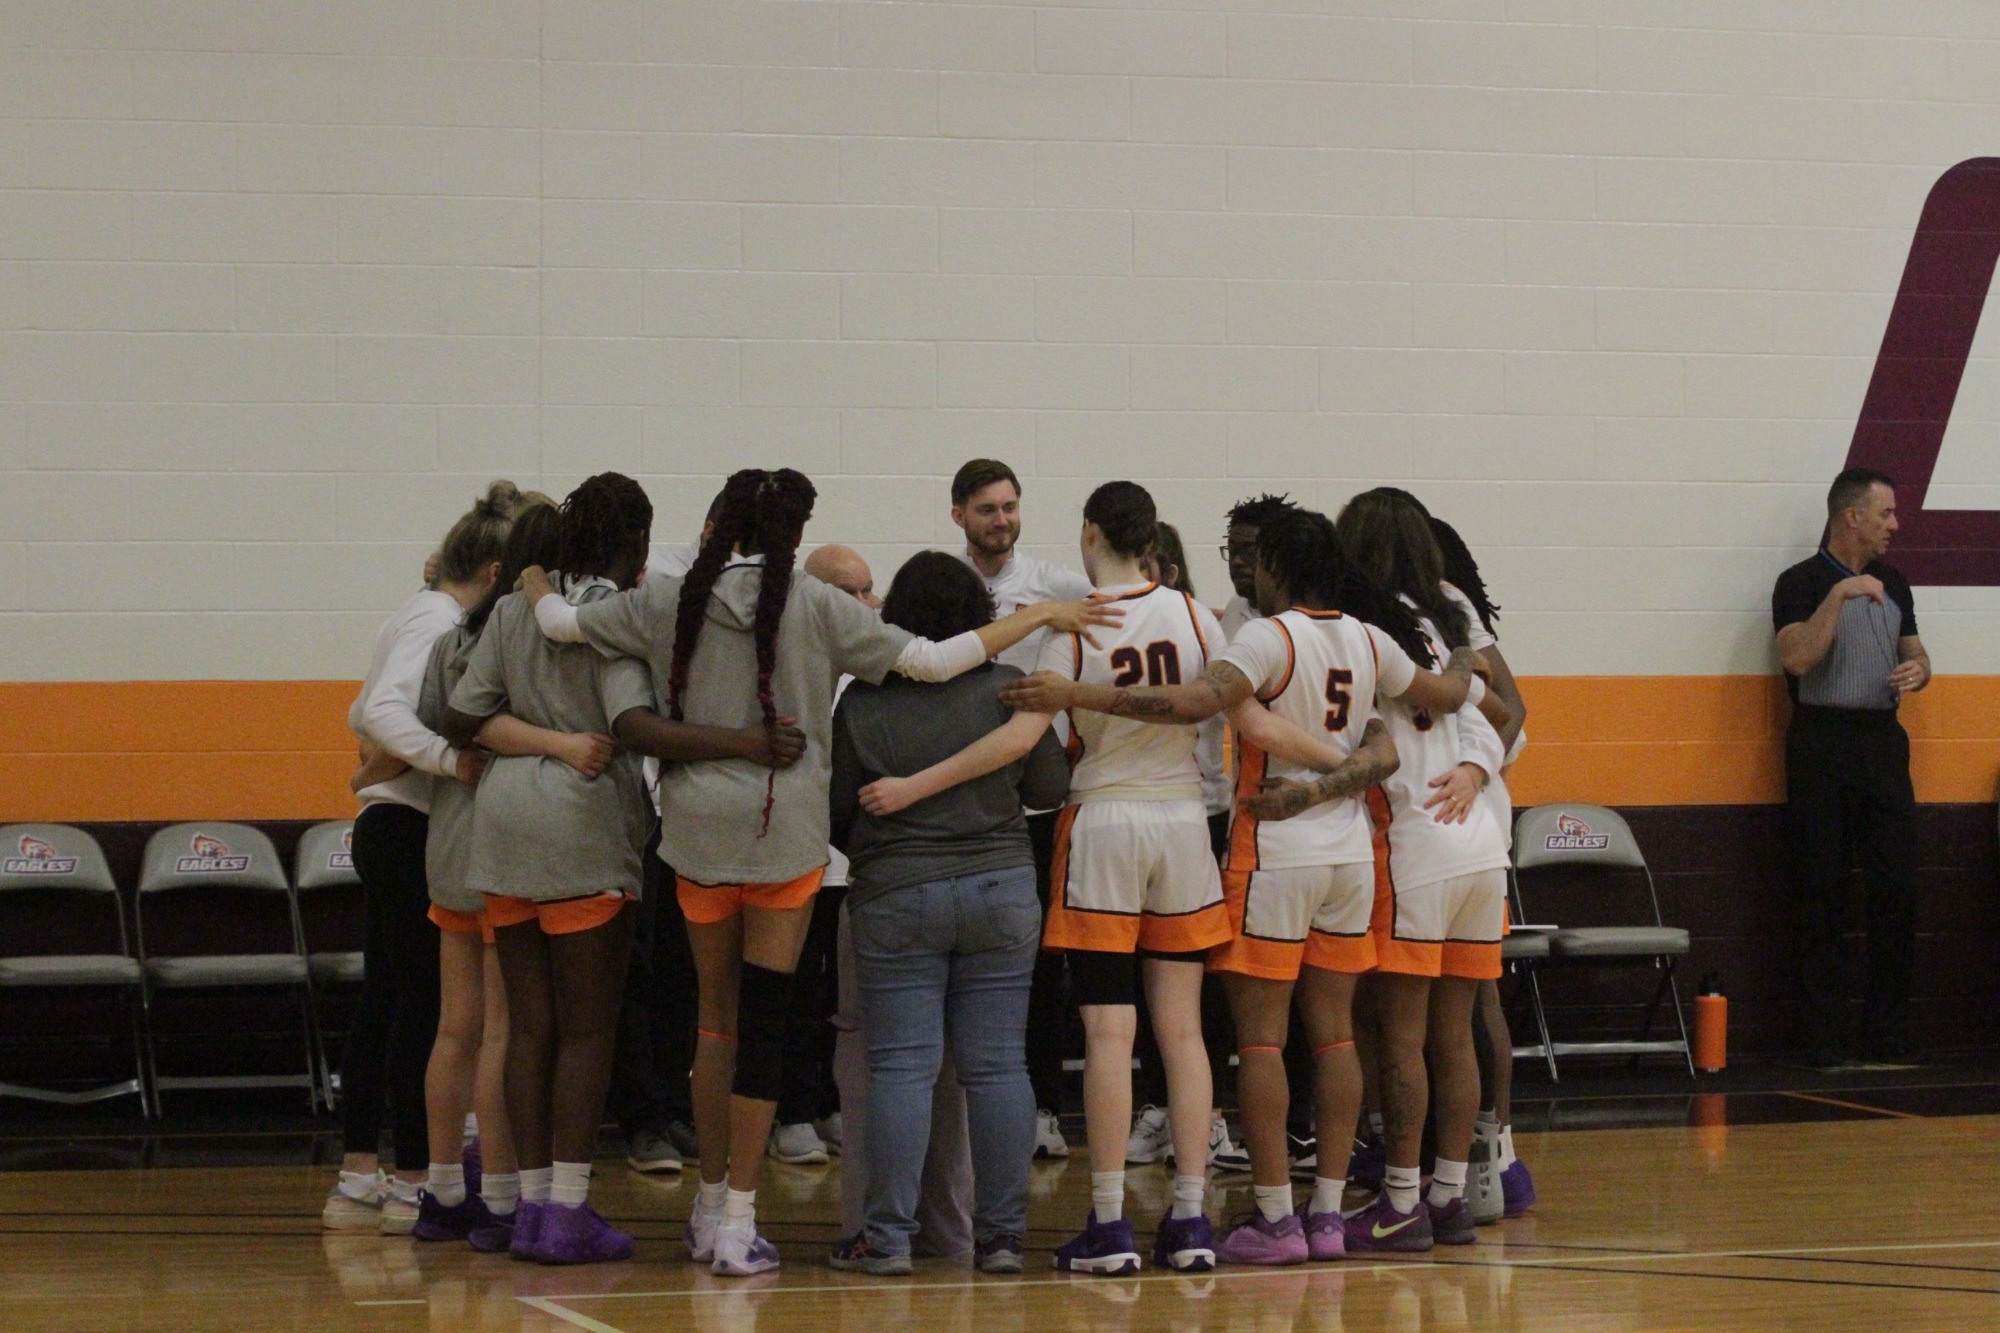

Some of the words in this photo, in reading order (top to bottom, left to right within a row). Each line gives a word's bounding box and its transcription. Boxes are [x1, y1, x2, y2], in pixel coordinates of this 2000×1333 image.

[1110, 640, 1183, 687] 20
[1324, 667, 1354, 732] 5
[1548, 836, 1605, 849] EAGLES
[179, 858, 245, 871] EAGLES
